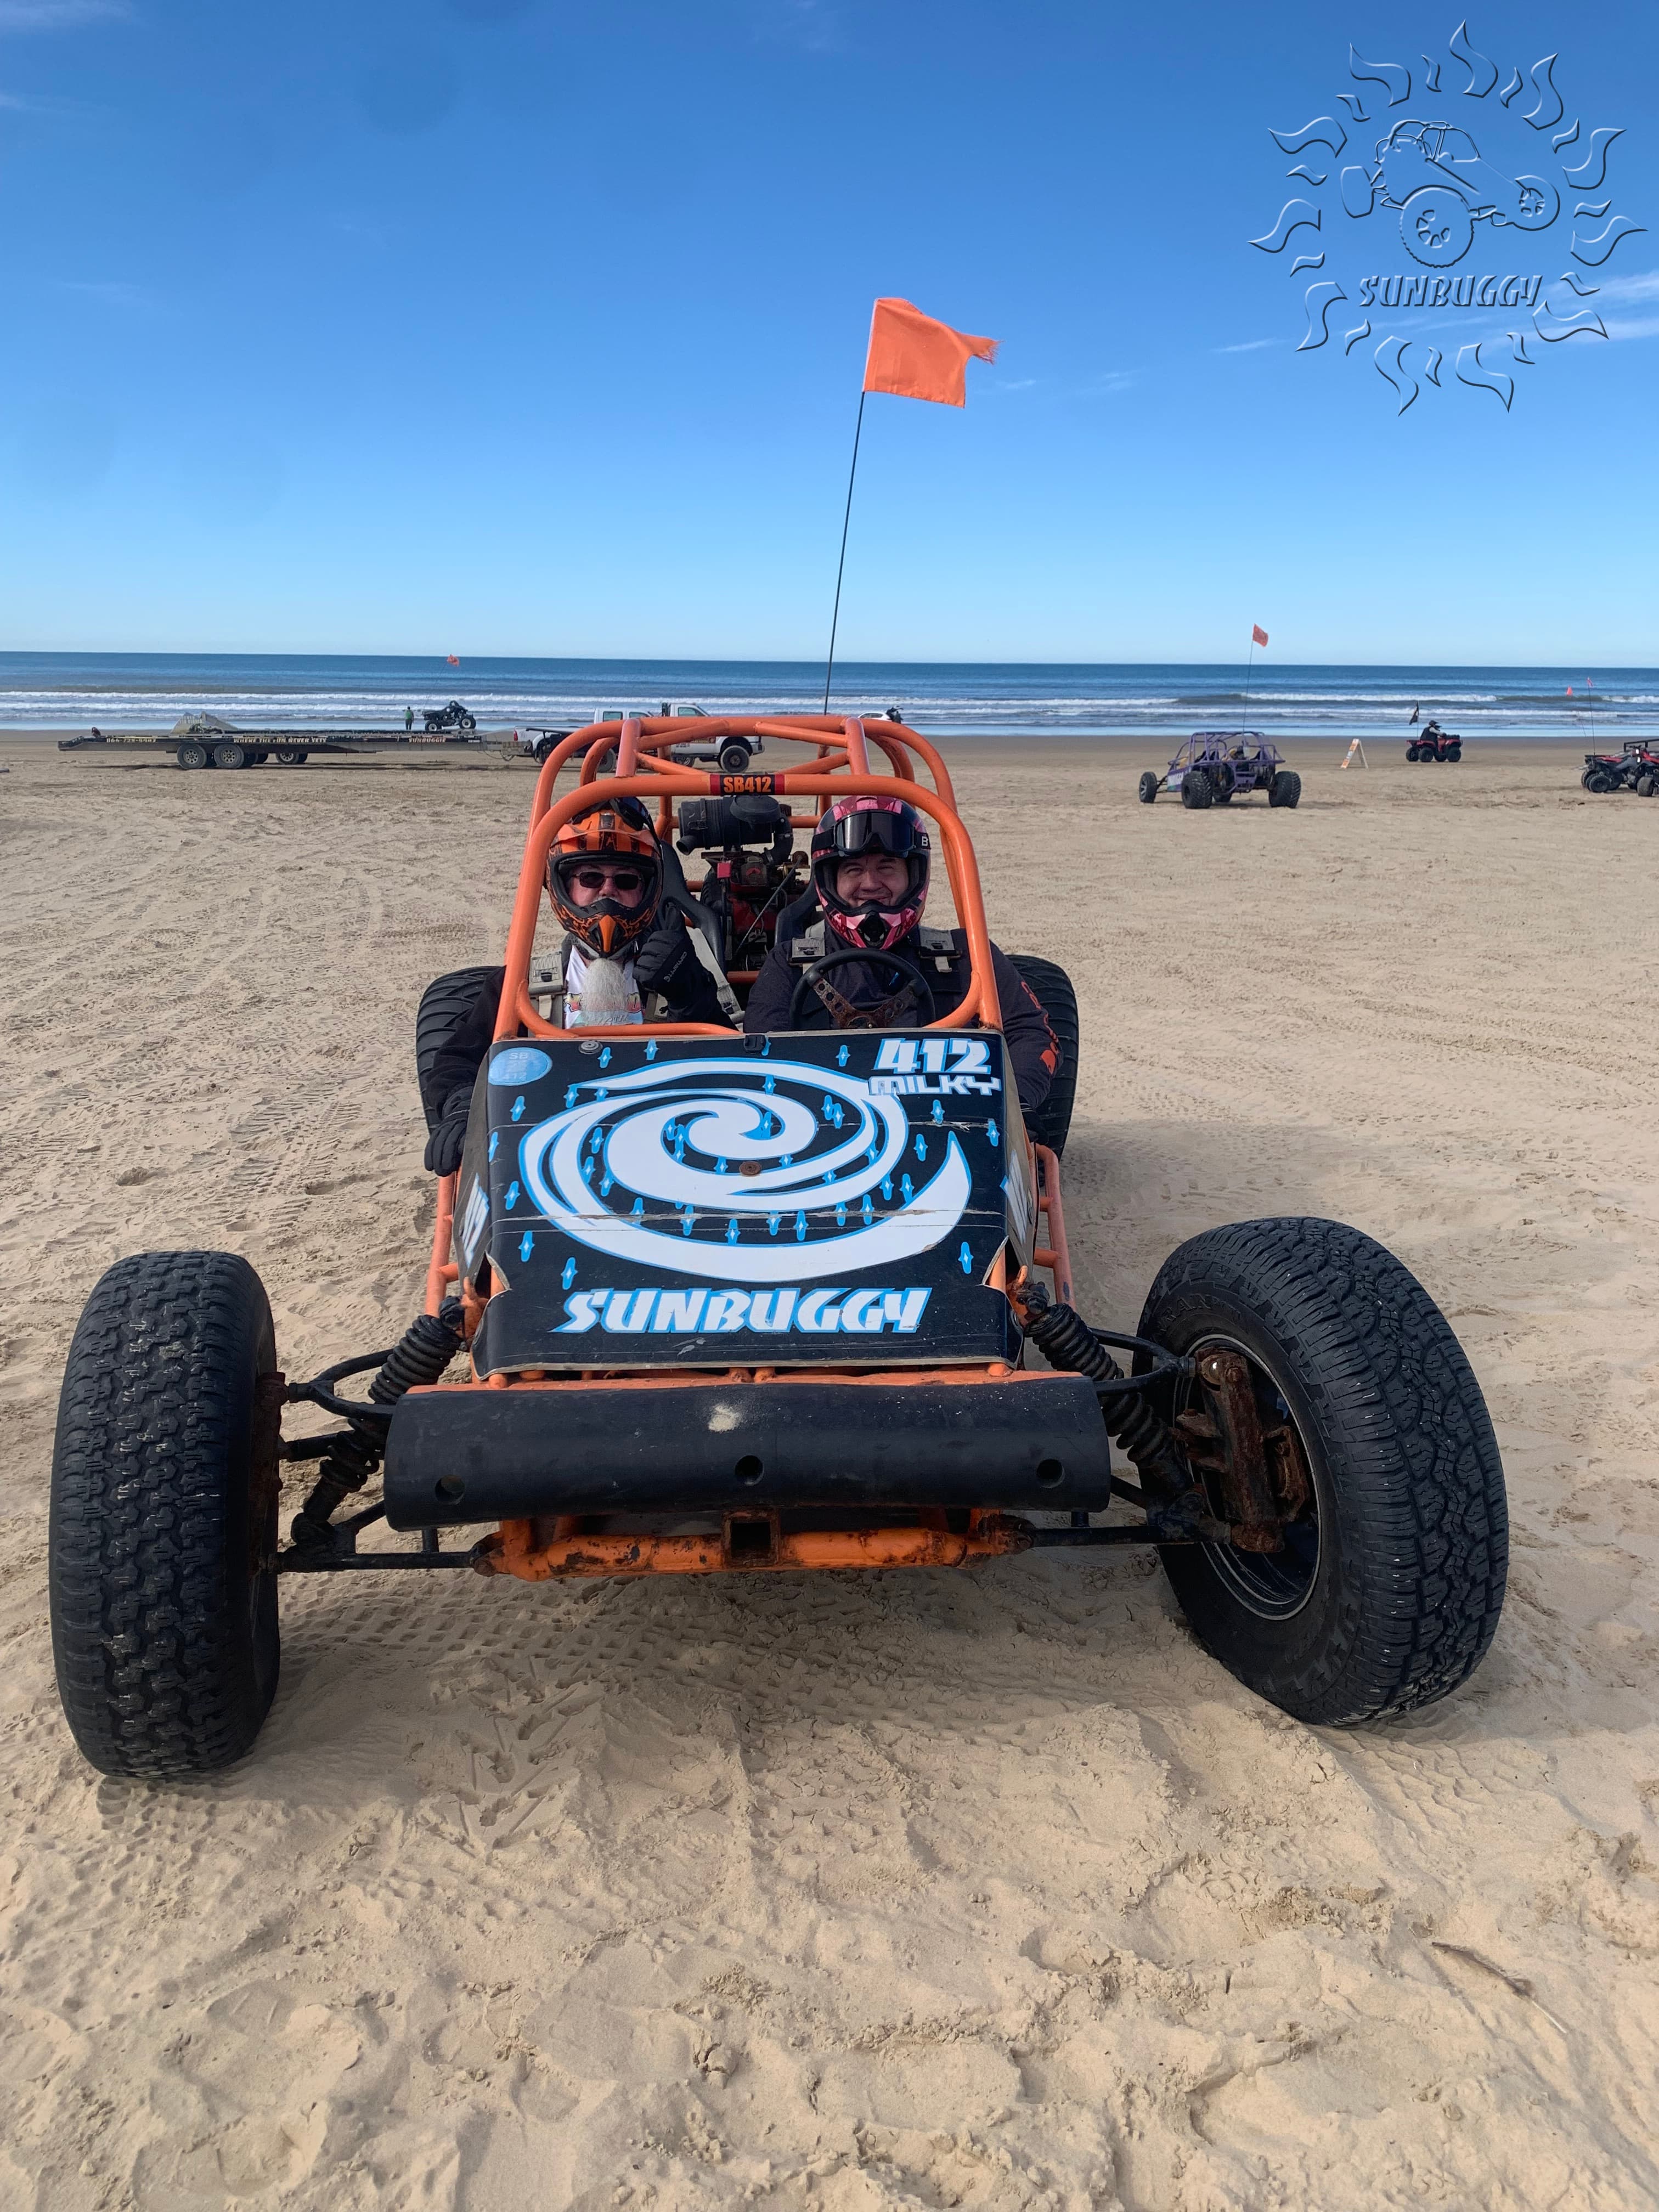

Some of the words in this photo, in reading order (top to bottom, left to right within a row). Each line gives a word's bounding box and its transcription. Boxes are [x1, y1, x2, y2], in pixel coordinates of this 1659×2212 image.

[723, 776, 772, 793] SB412
[873, 1038, 991, 1074] 412
[869, 1075, 1002, 1096] MILKY
[549, 1288, 933, 1334] SUNBUGGY
